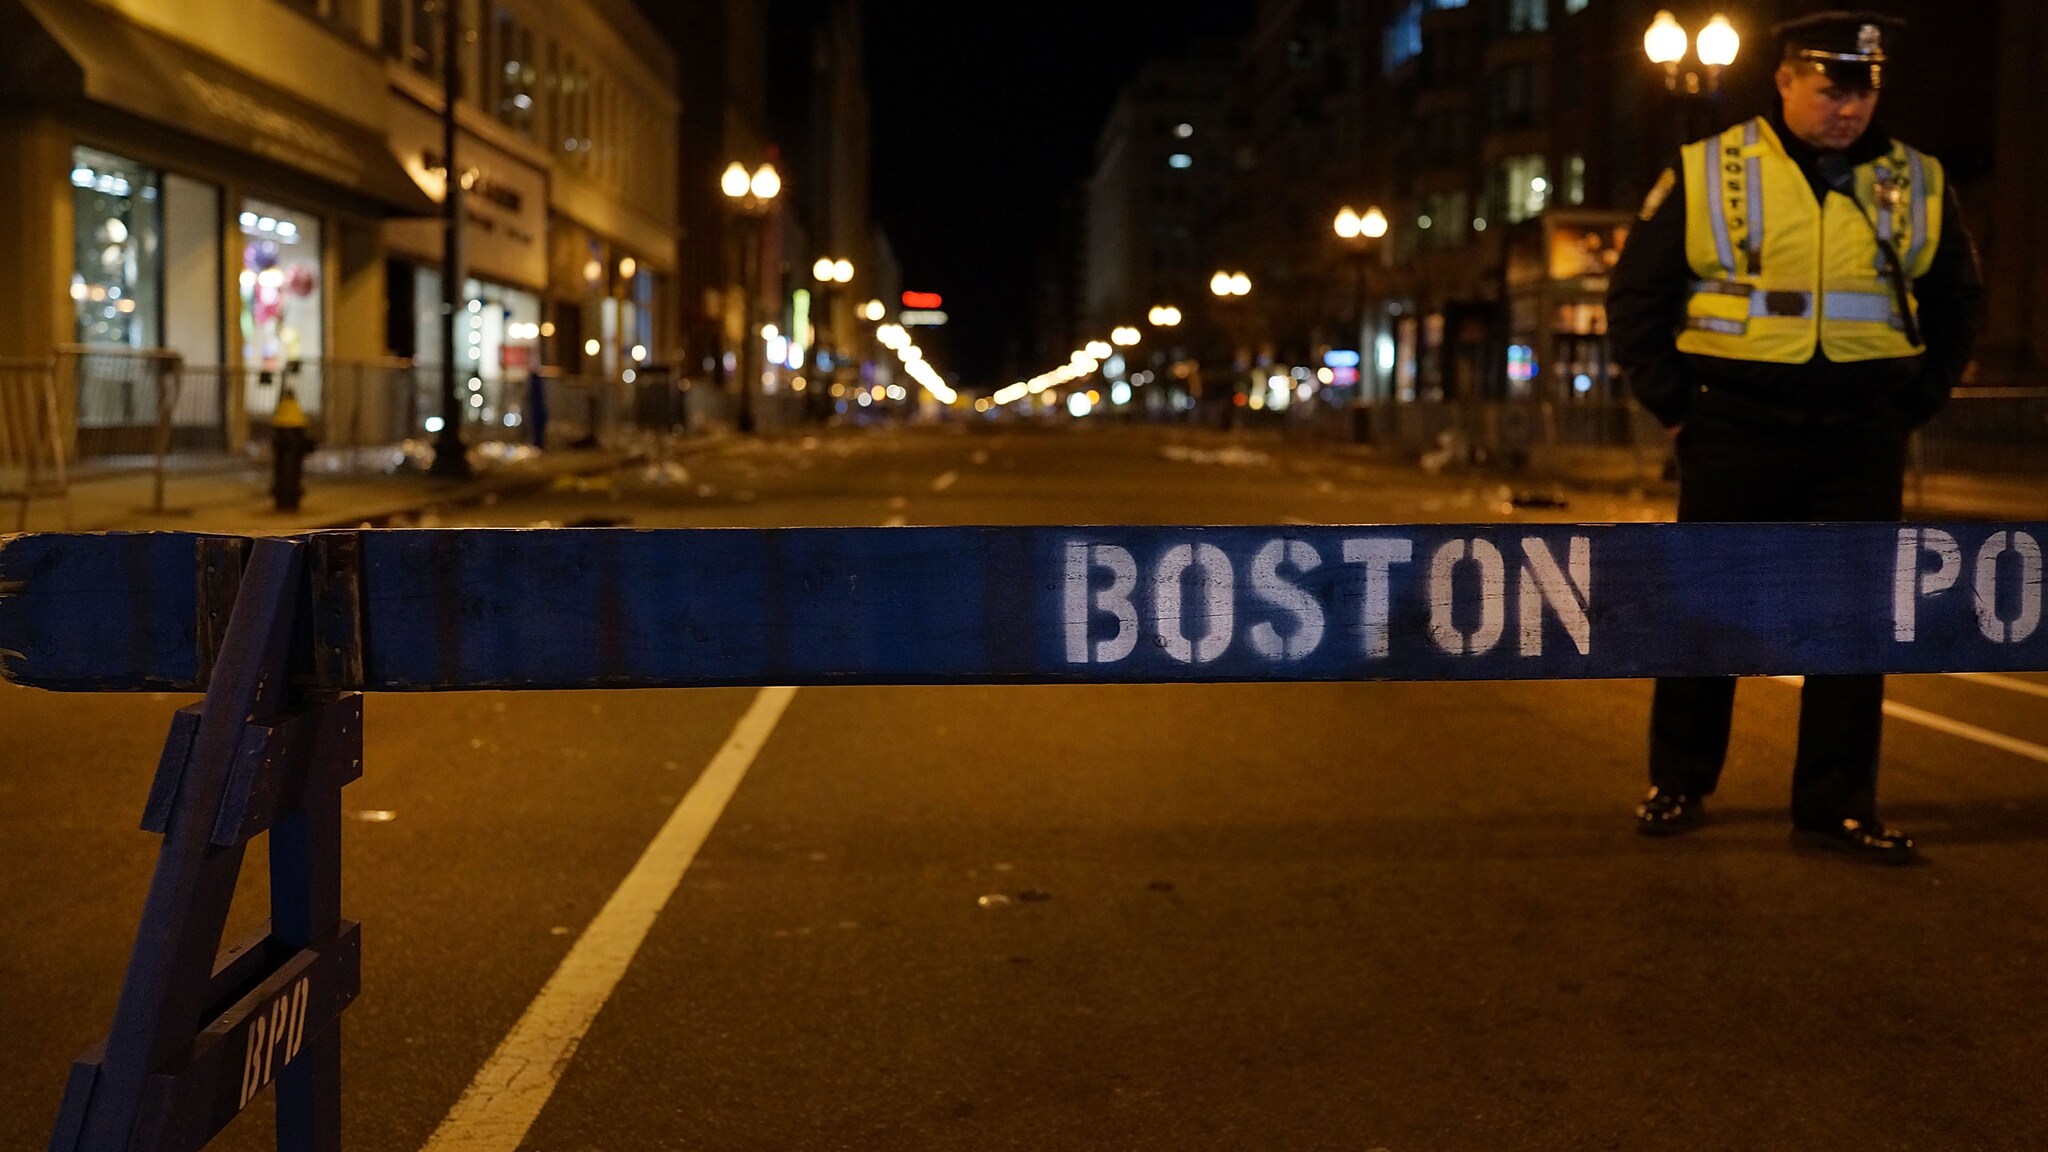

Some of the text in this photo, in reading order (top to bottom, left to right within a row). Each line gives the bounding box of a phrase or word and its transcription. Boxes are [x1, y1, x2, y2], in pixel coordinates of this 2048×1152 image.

[1064, 527, 2043, 662] BOSTON PO
[239, 977, 309, 1110] BPD
